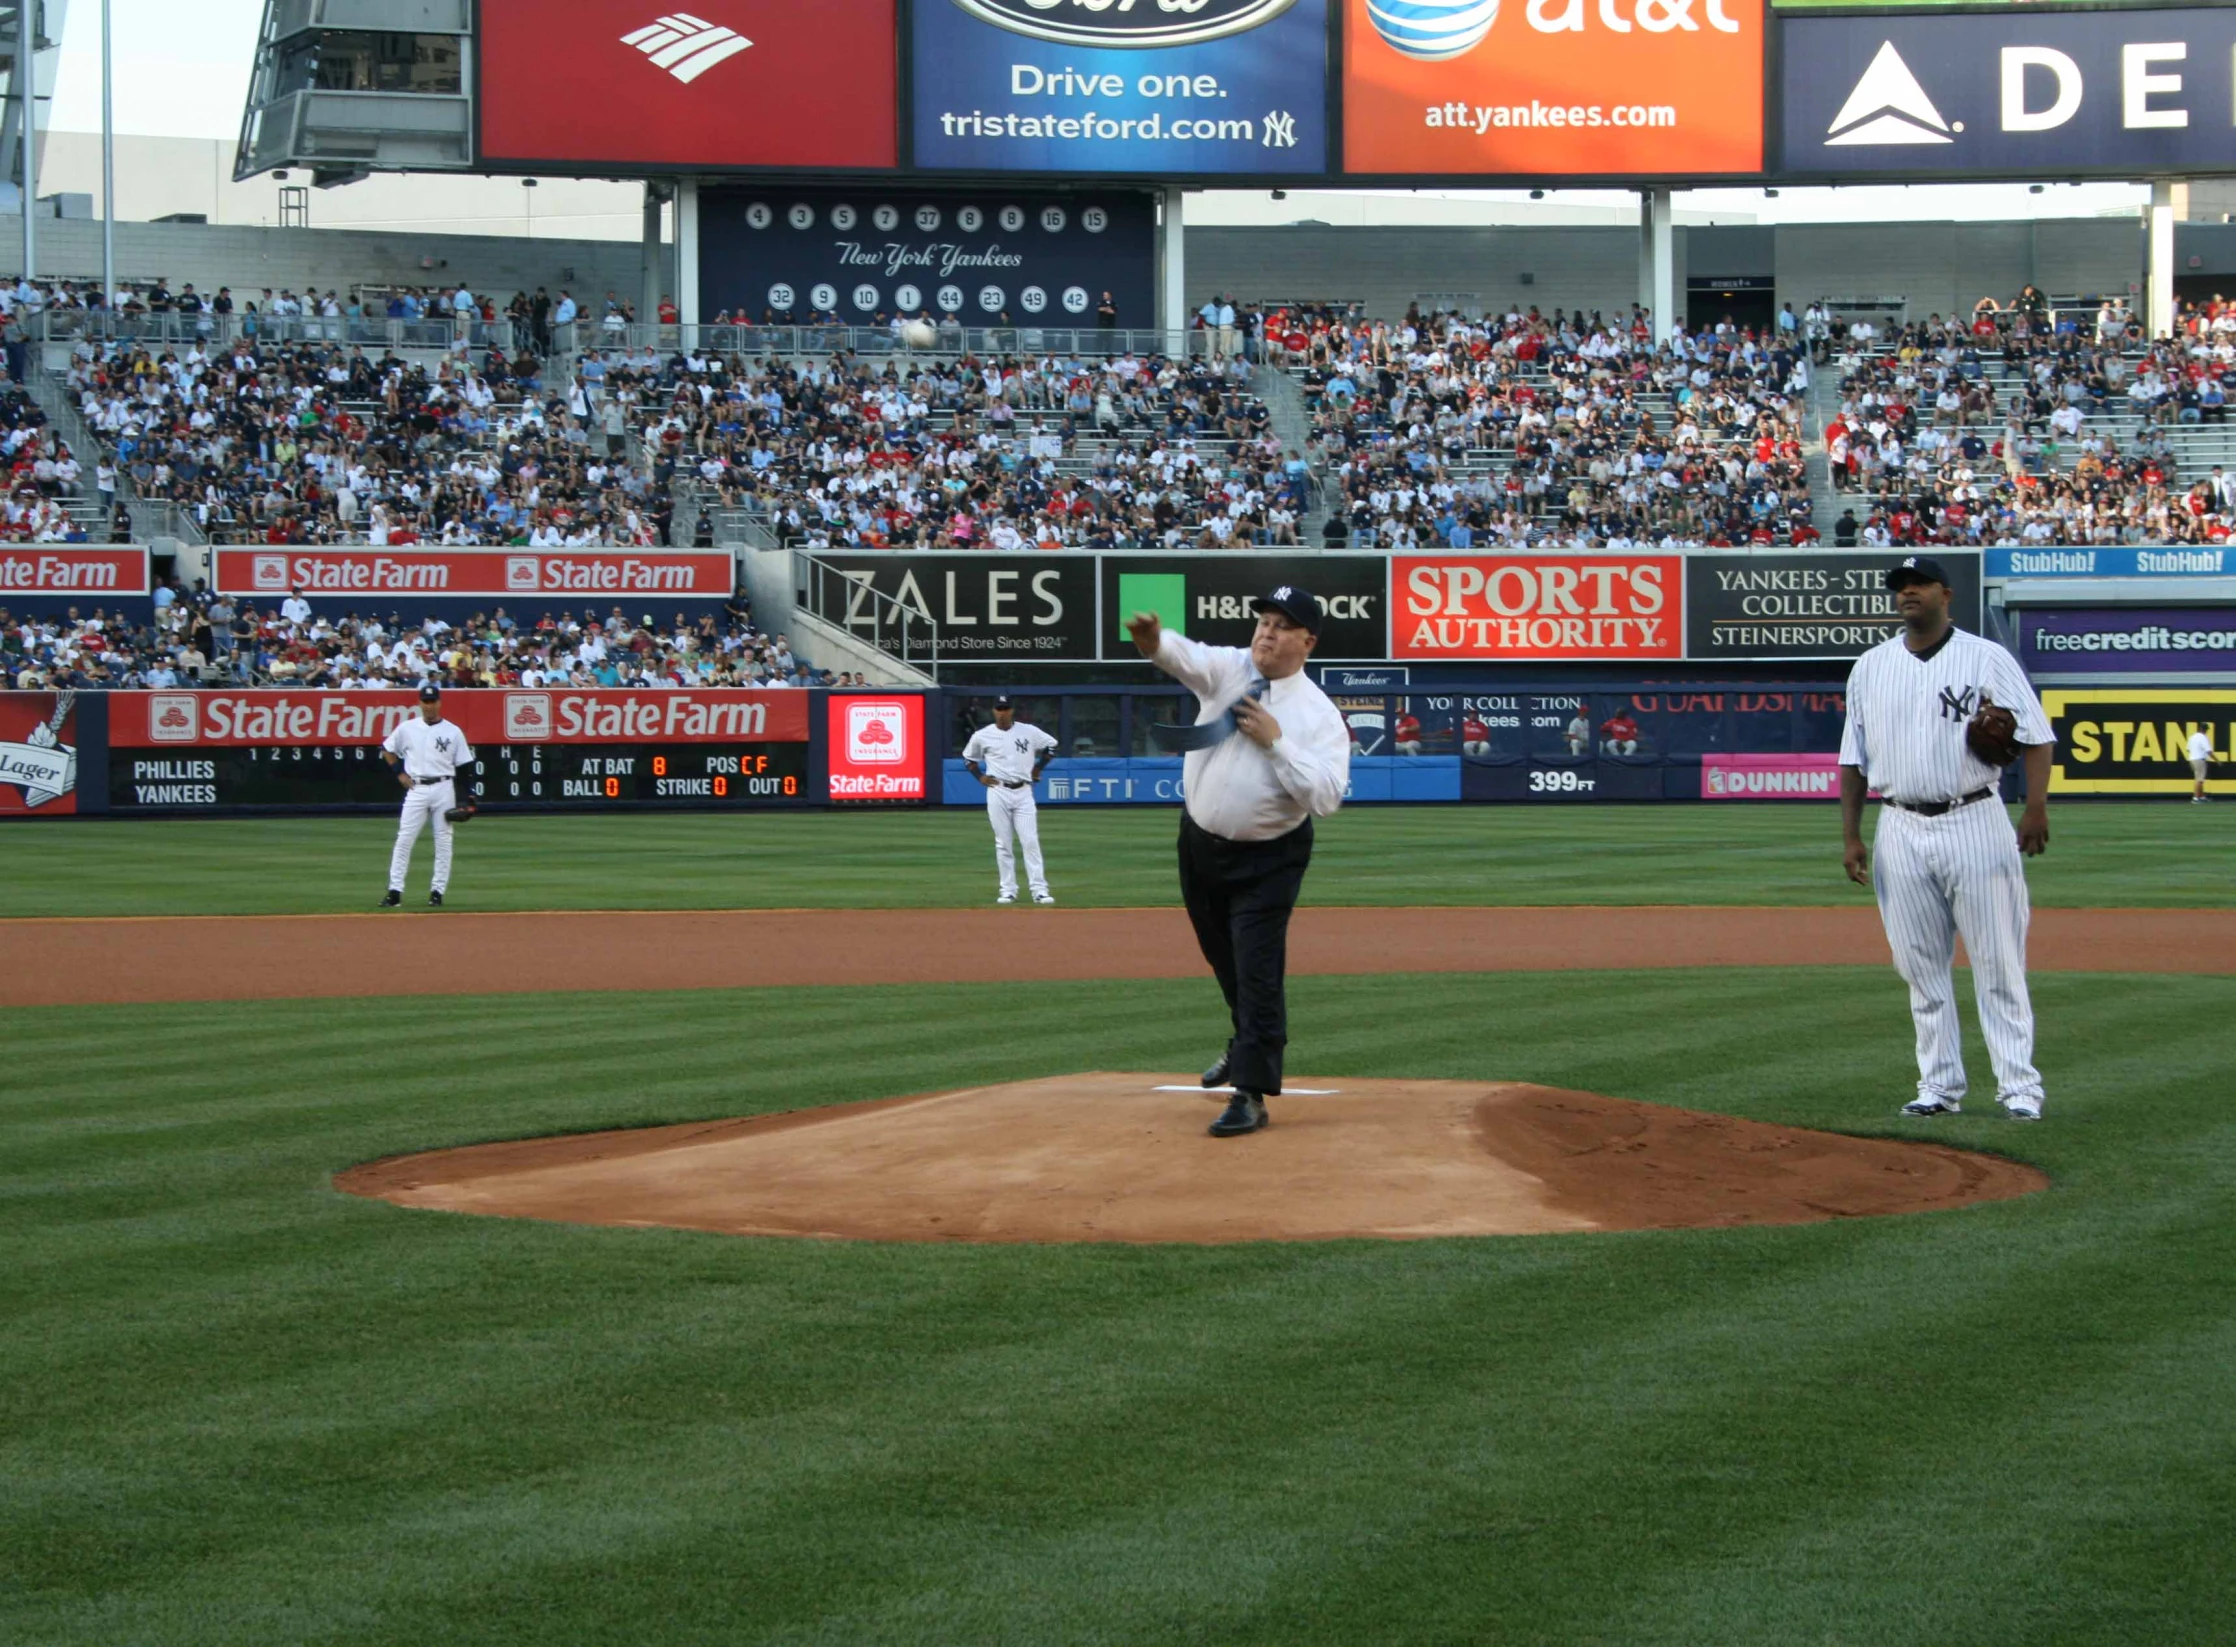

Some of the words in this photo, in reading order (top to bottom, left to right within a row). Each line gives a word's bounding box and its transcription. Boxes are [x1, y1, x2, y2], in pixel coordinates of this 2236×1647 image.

[1011, 64, 1124, 97] Drive
[1137, 71, 1228, 98] one.
[941, 111, 1253, 140] tristateford.com
[1425, 100, 1676, 134] att.yankees.com
[834, 241, 883, 265] New
[884, 243, 937, 277] York
[938, 243, 1023, 277] Yankees
[36, 556, 117, 587] Farm
[292, 557, 370, 588] State
[372, 558, 449, 588] Farm
[543, 558, 620, 589] State
[621, 559, 695, 589] Farm
[2010, 551, 2096, 573] StubHub!
[2137, 551, 2224, 572] StubHub!
[842, 568, 1064, 626] ZALES
[1407, 565, 1664, 616] SPORTS
[960, 636, 994, 649] Store
[997, 636, 1032, 649] Since
[1033, 636, 1062, 648] 1924
[556, 695, 661, 737] State
[663, 696, 767, 737] Farm
[1427, 697, 1475, 711] YOR
[1938, 684, 1975, 722] NY
[204, 697, 314, 739] State
[250, 747, 257, 760] 1
[271, 747, 281, 760] 2
[292, 747, 302, 760] 3
[313, 747, 322, 760] 4
[334, 747, 344, 760] 5
[355, 746, 365, 760] 6
[501, 745, 511, 758] H
[533, 745, 542, 758] E
[582, 758, 601, 775] AT
[605, 758, 636, 775] BAT
[706, 756, 738, 774] POS
[0, 754, 60, 780] Lager
[134, 760, 215, 780] PHILLIES
[475, 760, 485, 775] 0
[509, 760, 519, 775] 0
[532, 760, 542, 775] 0
[135, 785, 216, 804] YANKEES
[475, 781, 485, 796] 0
[510, 781, 520, 796] 0
[532, 781, 542, 796] 0
[563, 779, 603, 796] BALL
[656, 778, 711, 796] STRIKE
[749, 777, 781, 795] OUT
[829, 774, 875, 794] State
[875, 773, 921, 793] Farm
[1073, 778, 1133, 798] FTI
[1728, 771, 1837, 792] DUNKIN'
